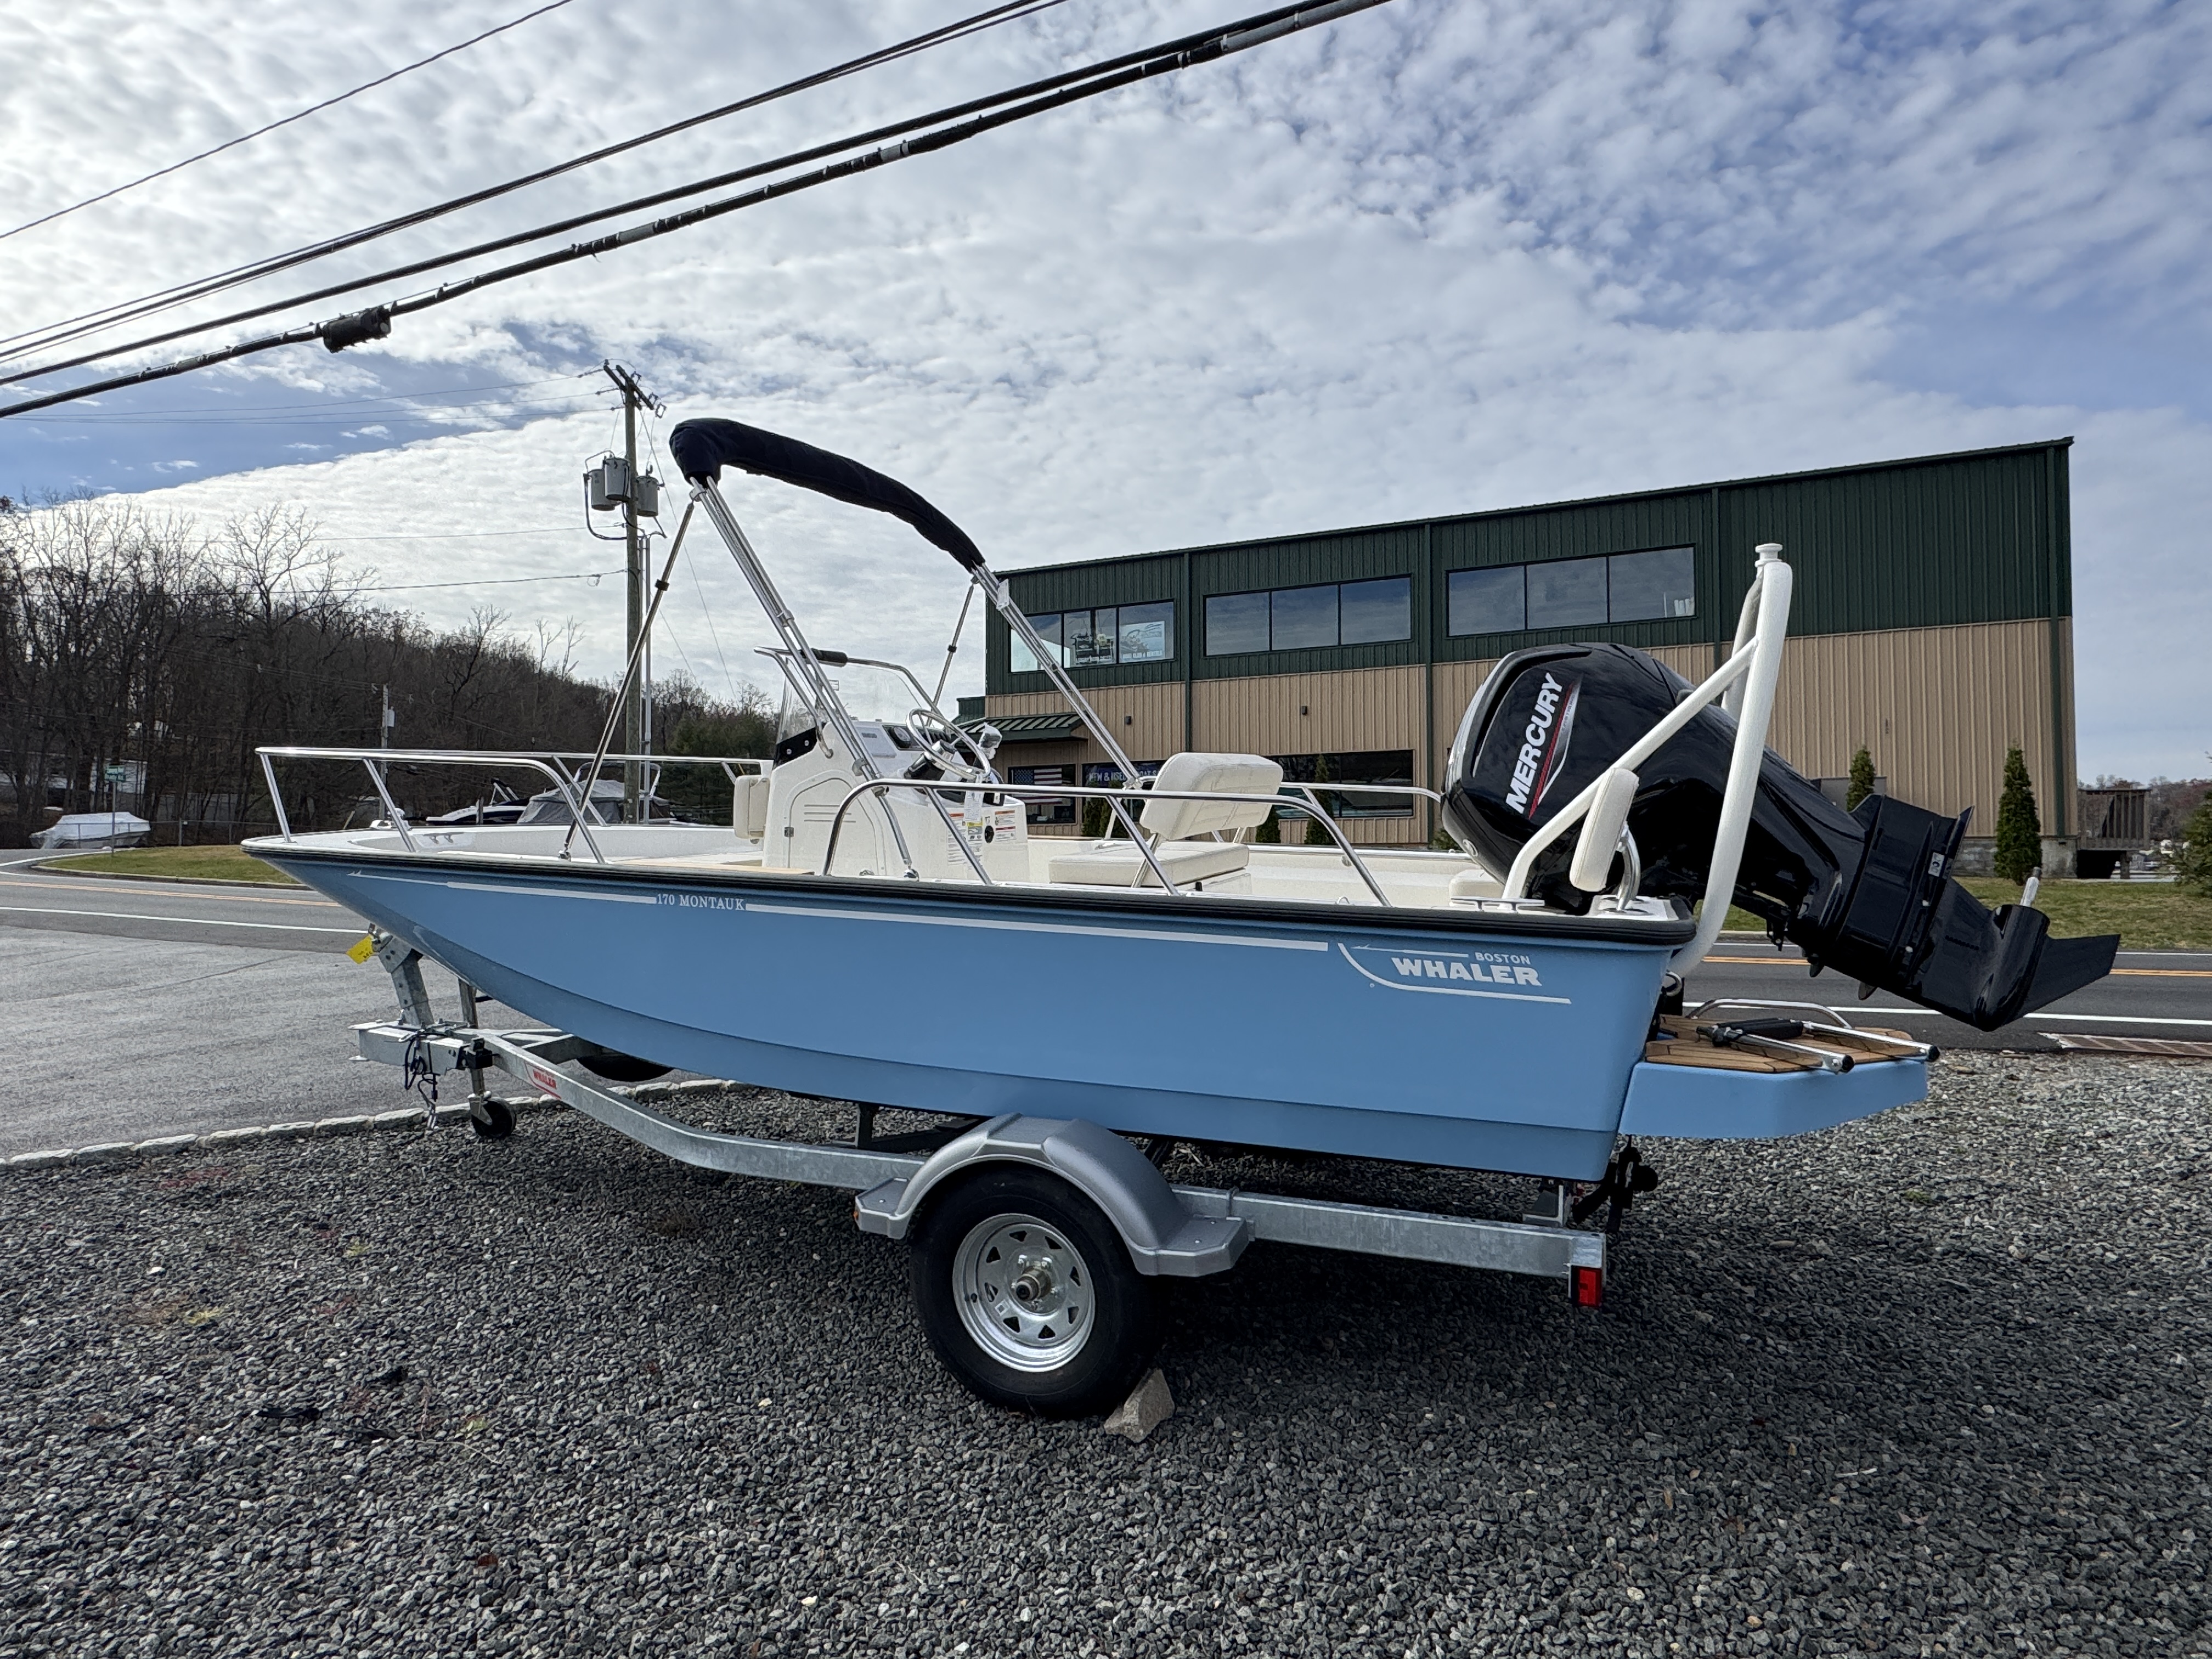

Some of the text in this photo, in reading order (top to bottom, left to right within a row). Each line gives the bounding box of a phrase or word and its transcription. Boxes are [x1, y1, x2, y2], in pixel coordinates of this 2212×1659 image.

[1505, 673, 1562, 814] MERCURY
[657, 893, 745, 911] 170 MONTAUK
[1475, 952, 1531, 964] BOSTON
[1391, 957, 1543, 986] WHALER
